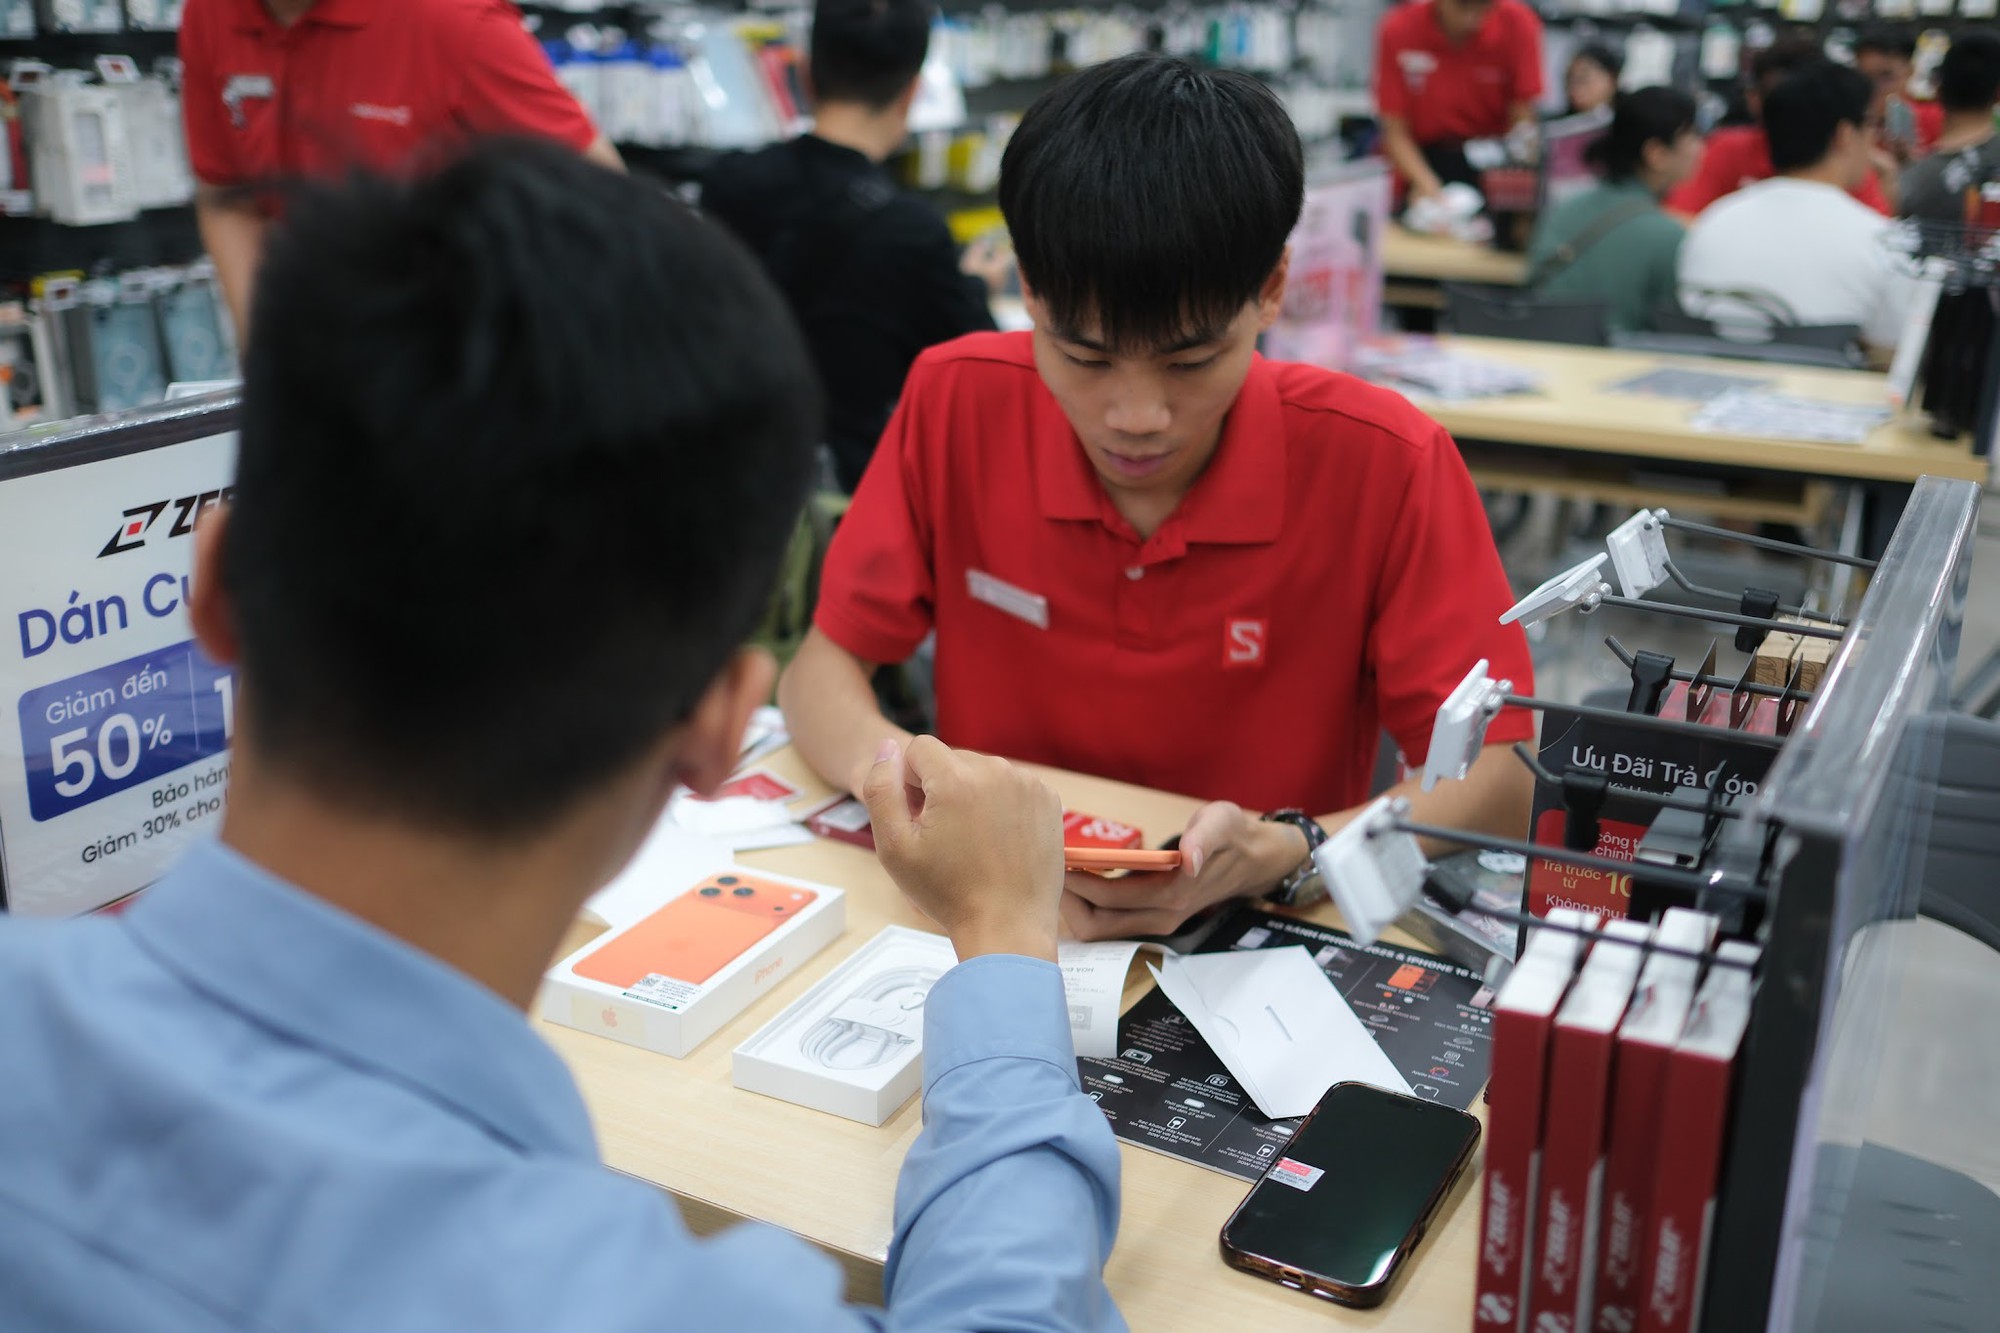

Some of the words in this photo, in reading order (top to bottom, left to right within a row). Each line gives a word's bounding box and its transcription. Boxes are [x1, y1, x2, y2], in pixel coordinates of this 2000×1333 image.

[18, 590, 128, 658] Dán
[1229, 621, 1263, 660] S
[45, 688, 116, 724] Giảm
[122, 663, 167, 700] đến
[50, 713, 172, 797] 50%
[1572, 745, 1605, 771] Ưu
[1612, 753, 1654, 779] Đãi
[1660, 761, 1698, 787] Trả
[152, 783, 189, 809] Bảo
[194, 760, 233, 792] hàn
[82, 831, 137, 863] Giảm
[142, 810, 181, 839] 30%
[186, 797, 220, 822] cho
[1566, 864, 1601, 880] trước
[1595, 845, 1633, 862] chính
[1406, 955, 1454, 973] IPHONE
